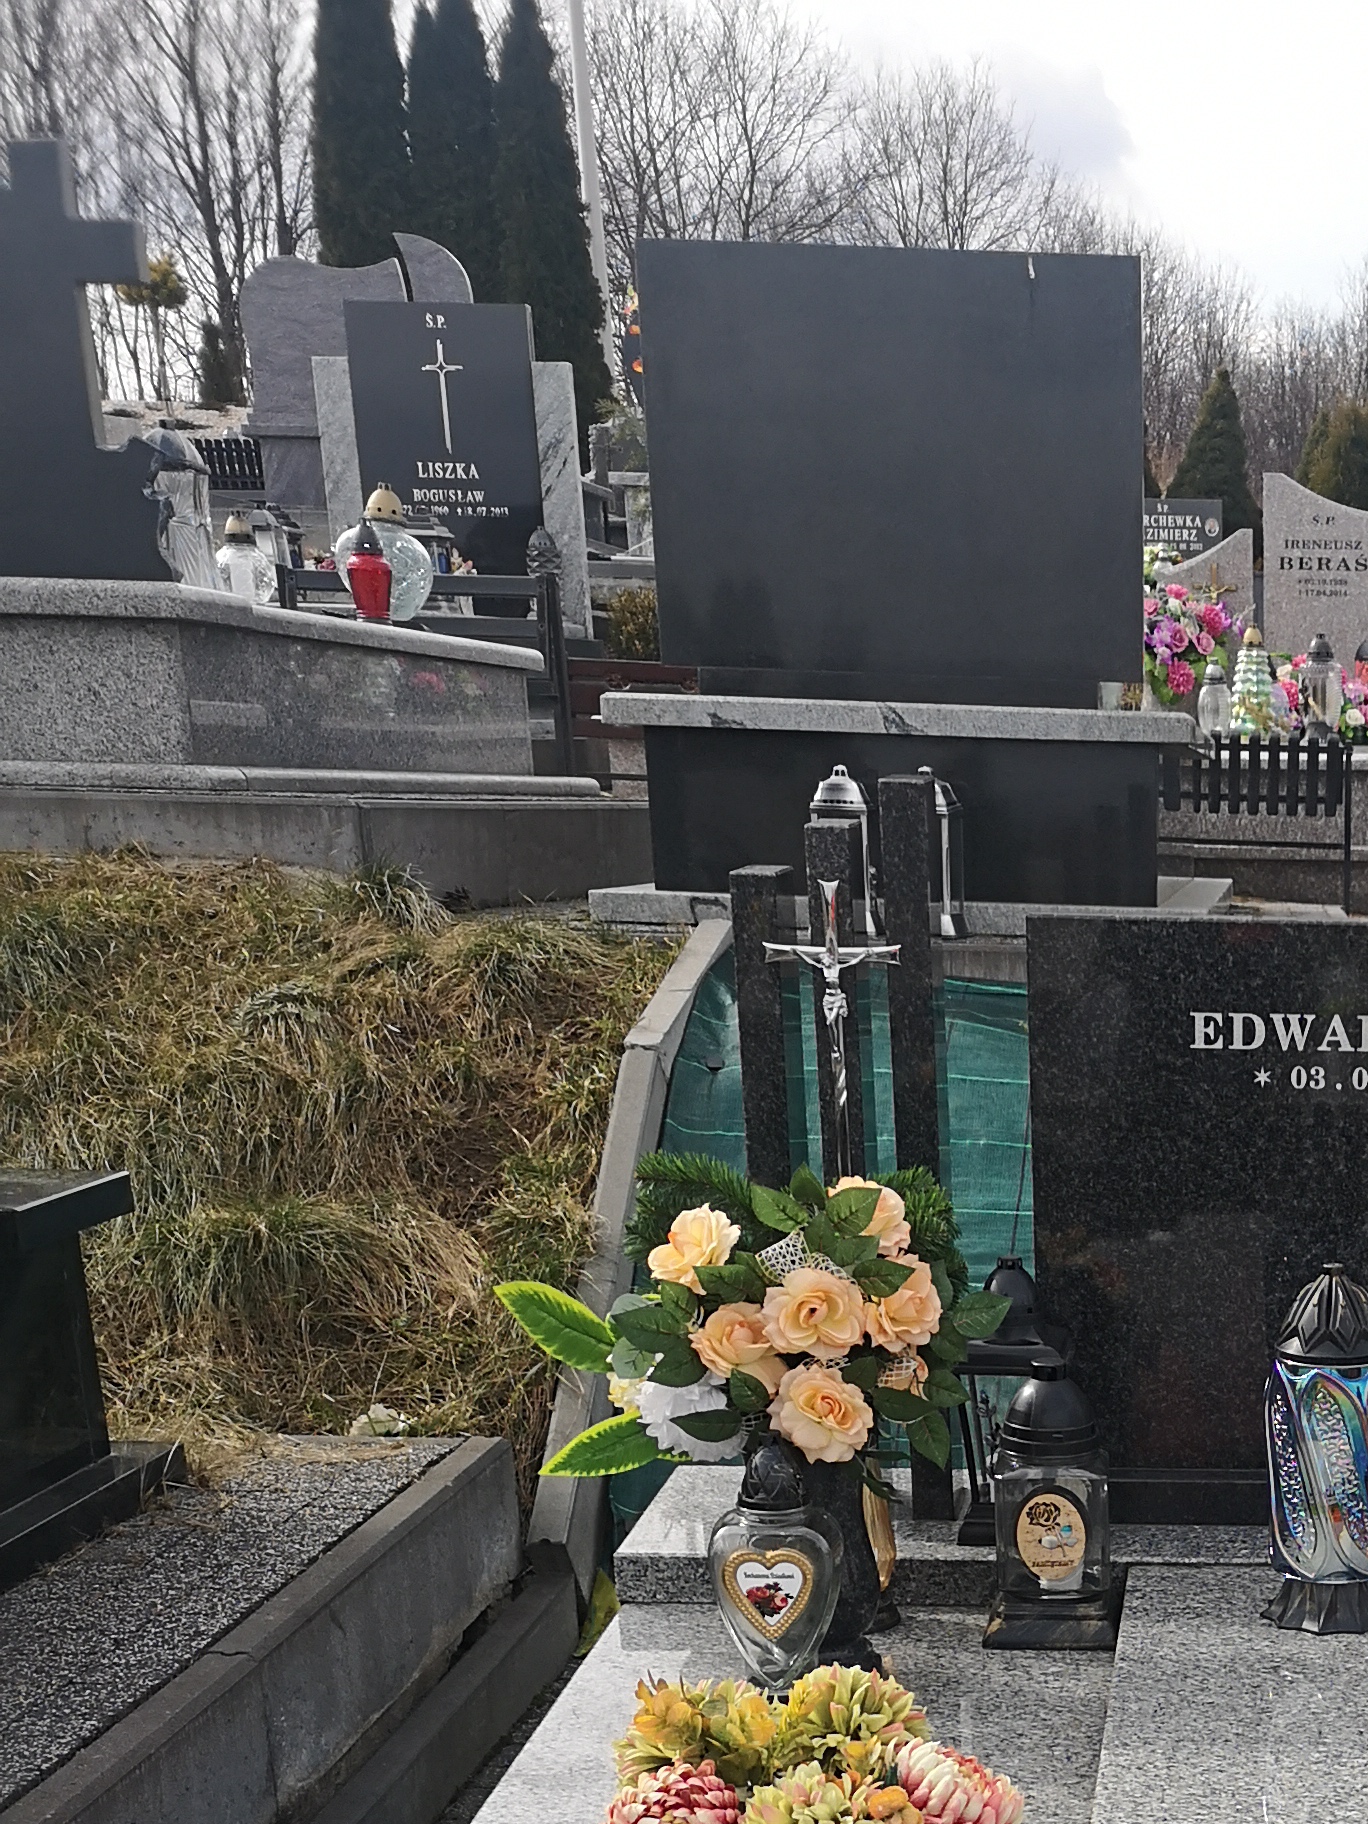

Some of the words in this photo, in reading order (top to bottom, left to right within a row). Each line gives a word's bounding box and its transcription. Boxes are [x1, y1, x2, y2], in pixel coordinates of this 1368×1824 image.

[416, 461, 480, 480] LISZKA
[412, 488, 485, 503] BOGUSŁAW
[1143, 514, 1202, 528] RCHEWKA
[1143, 528, 1198, 541] ZIMIERZ
[1284, 538, 1363, 551] IRENEUSZ
[1279, 553, 1368, 572] BERAŚ
